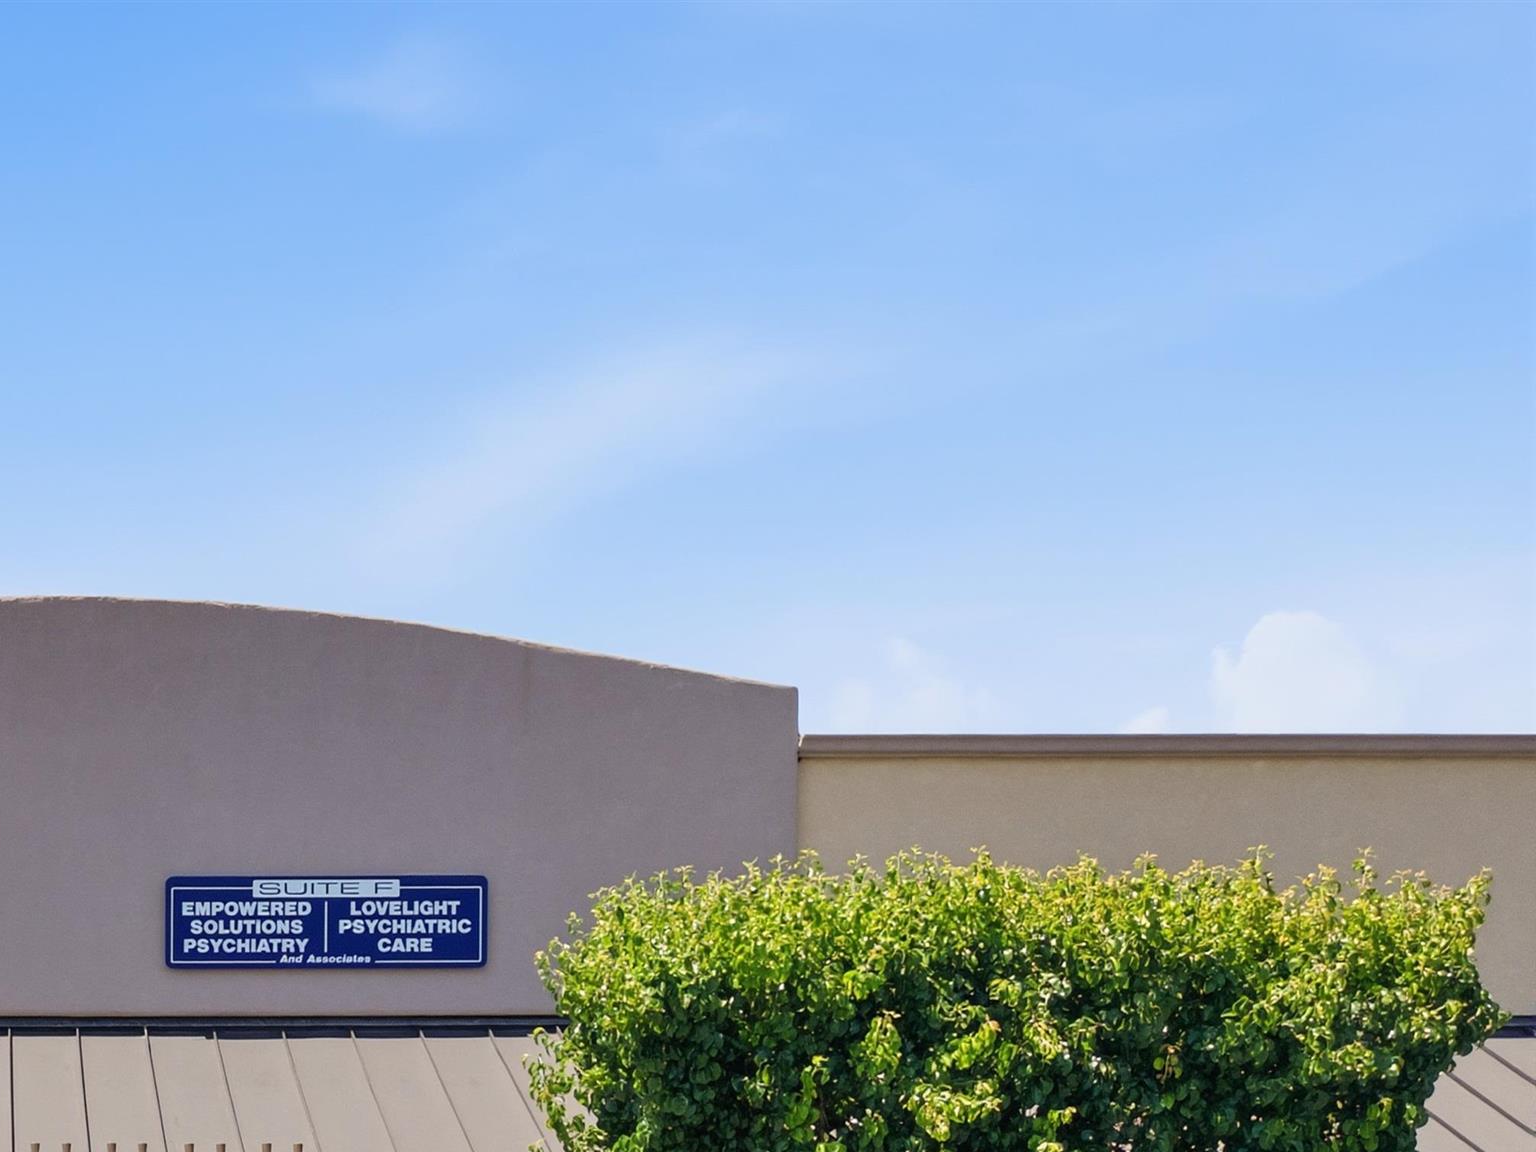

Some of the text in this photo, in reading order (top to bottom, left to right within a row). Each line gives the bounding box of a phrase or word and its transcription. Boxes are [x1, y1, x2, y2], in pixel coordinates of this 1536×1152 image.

[259, 881, 395, 895] SUITE F
[182, 901, 312, 917] EMPOWERED
[350, 900, 460, 916] LOVELIGHT
[190, 919, 304, 935] SOLUTIONS
[338, 919, 472, 935] PSYCHIATRIC
[183, 938, 310, 954] PSYCHIATRY
[377, 938, 433, 953] CARE
[280, 953, 372, 964] And Associates
